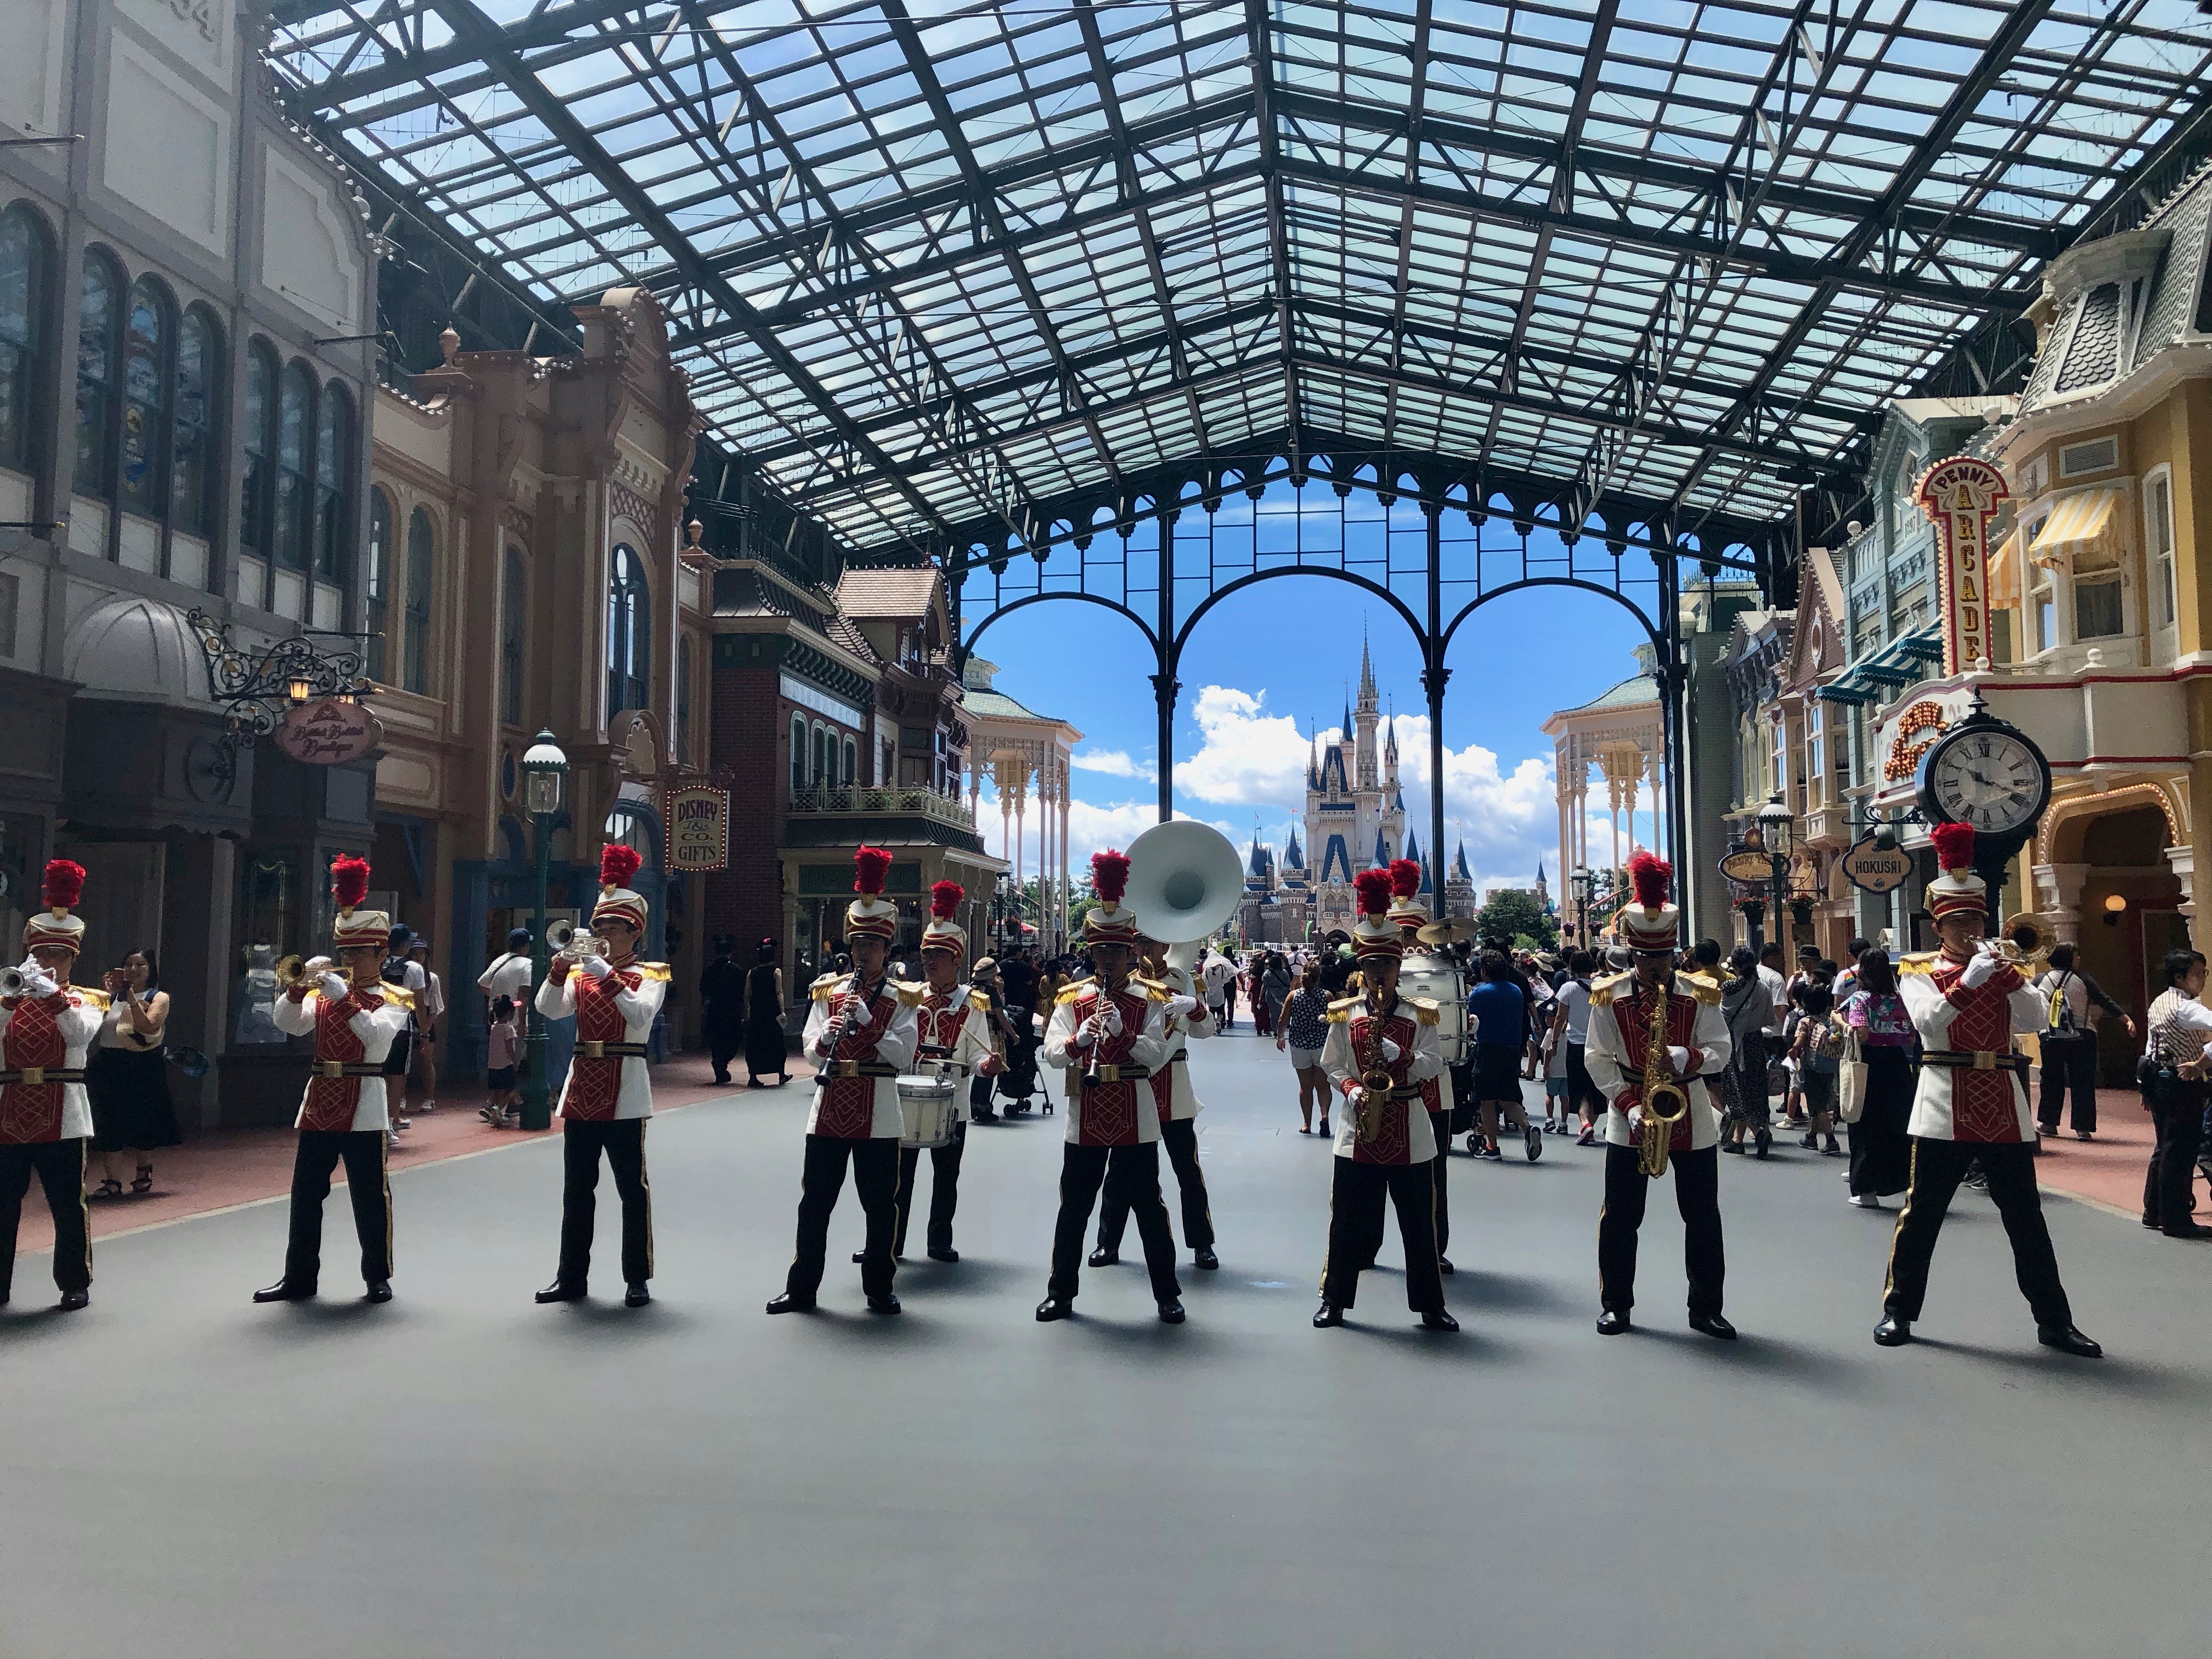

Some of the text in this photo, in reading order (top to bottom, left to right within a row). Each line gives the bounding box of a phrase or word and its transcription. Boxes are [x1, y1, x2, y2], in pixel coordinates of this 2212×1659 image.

[1934, 467, 1994, 490] PENNY
[1905, 516, 1916, 538] 1897
[1955, 484, 1980, 662] ARCADE
[678, 799, 718, 823] DISNEY
[679, 845, 715, 861] GIFTS
[1855, 860, 1901, 874] HOKUSAI
